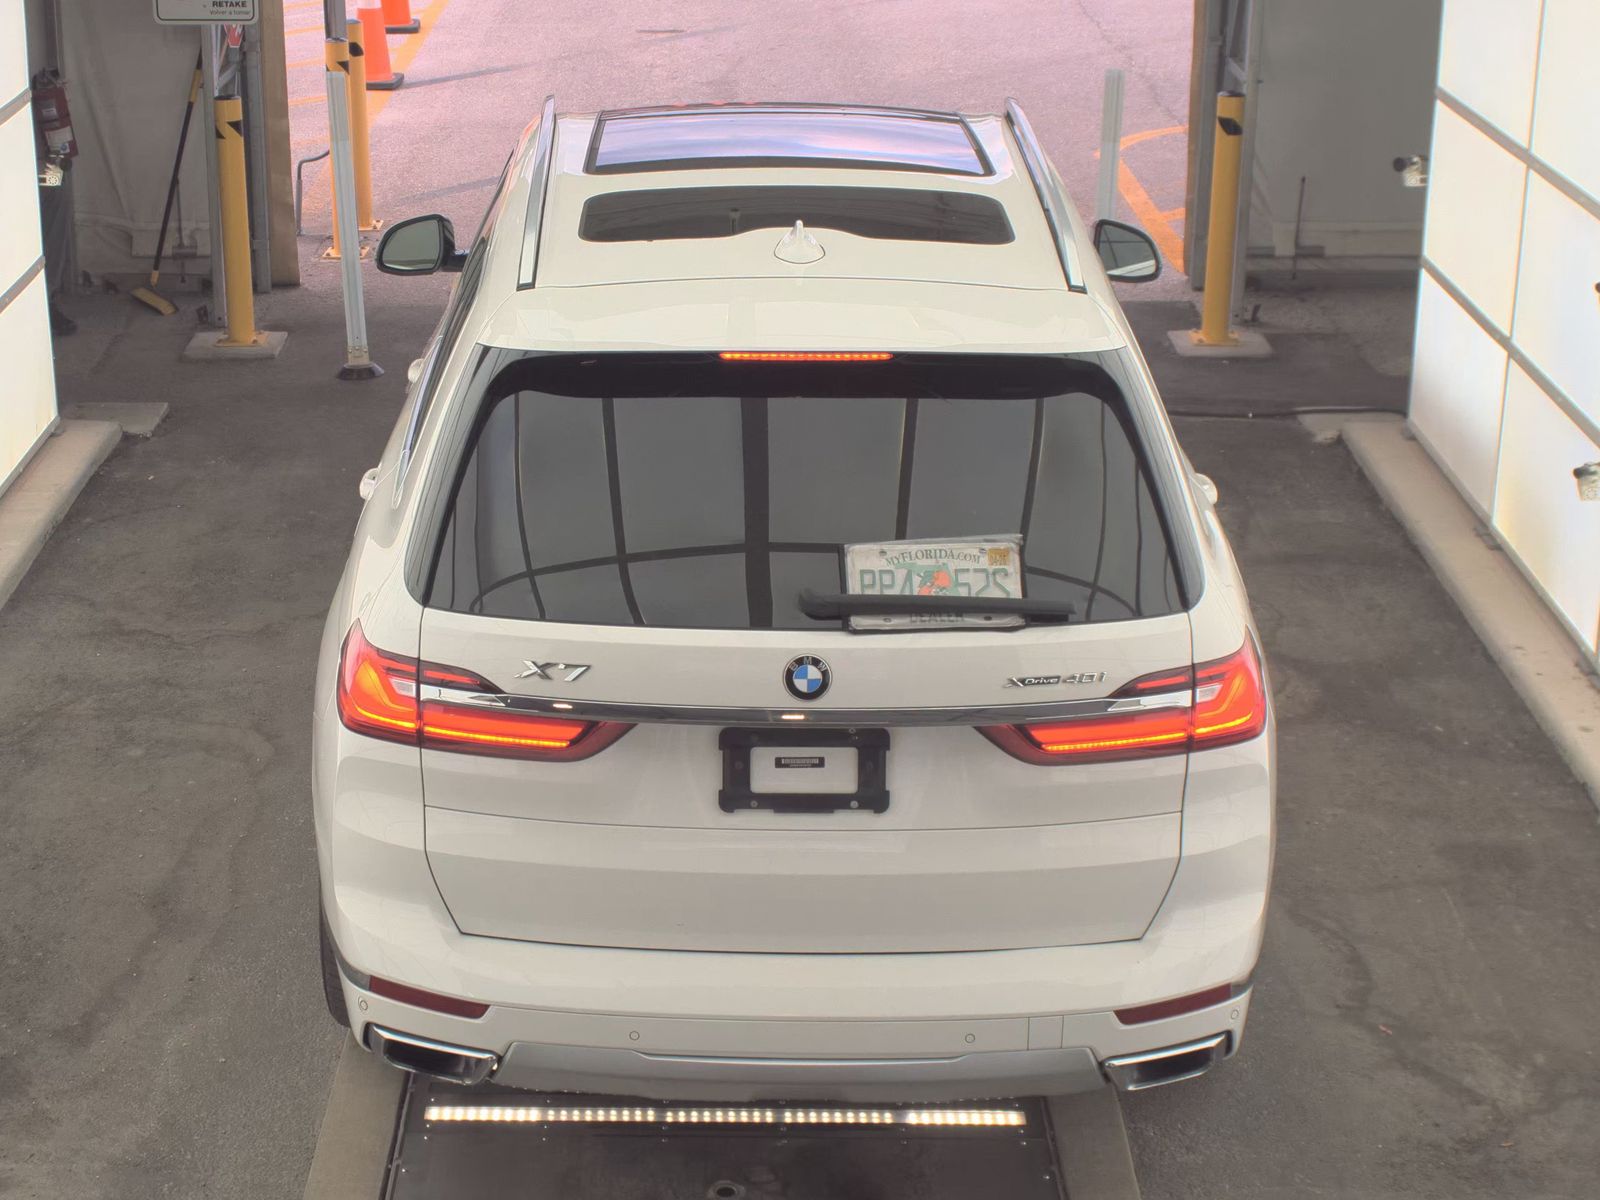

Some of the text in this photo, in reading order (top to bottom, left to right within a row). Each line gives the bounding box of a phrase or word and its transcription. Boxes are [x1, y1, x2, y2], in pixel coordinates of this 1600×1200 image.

[885, 548, 981, 568] MYFLORIDA.COM
[512, 659, 592, 682] X7
[788, 655, 828, 672] BMW
